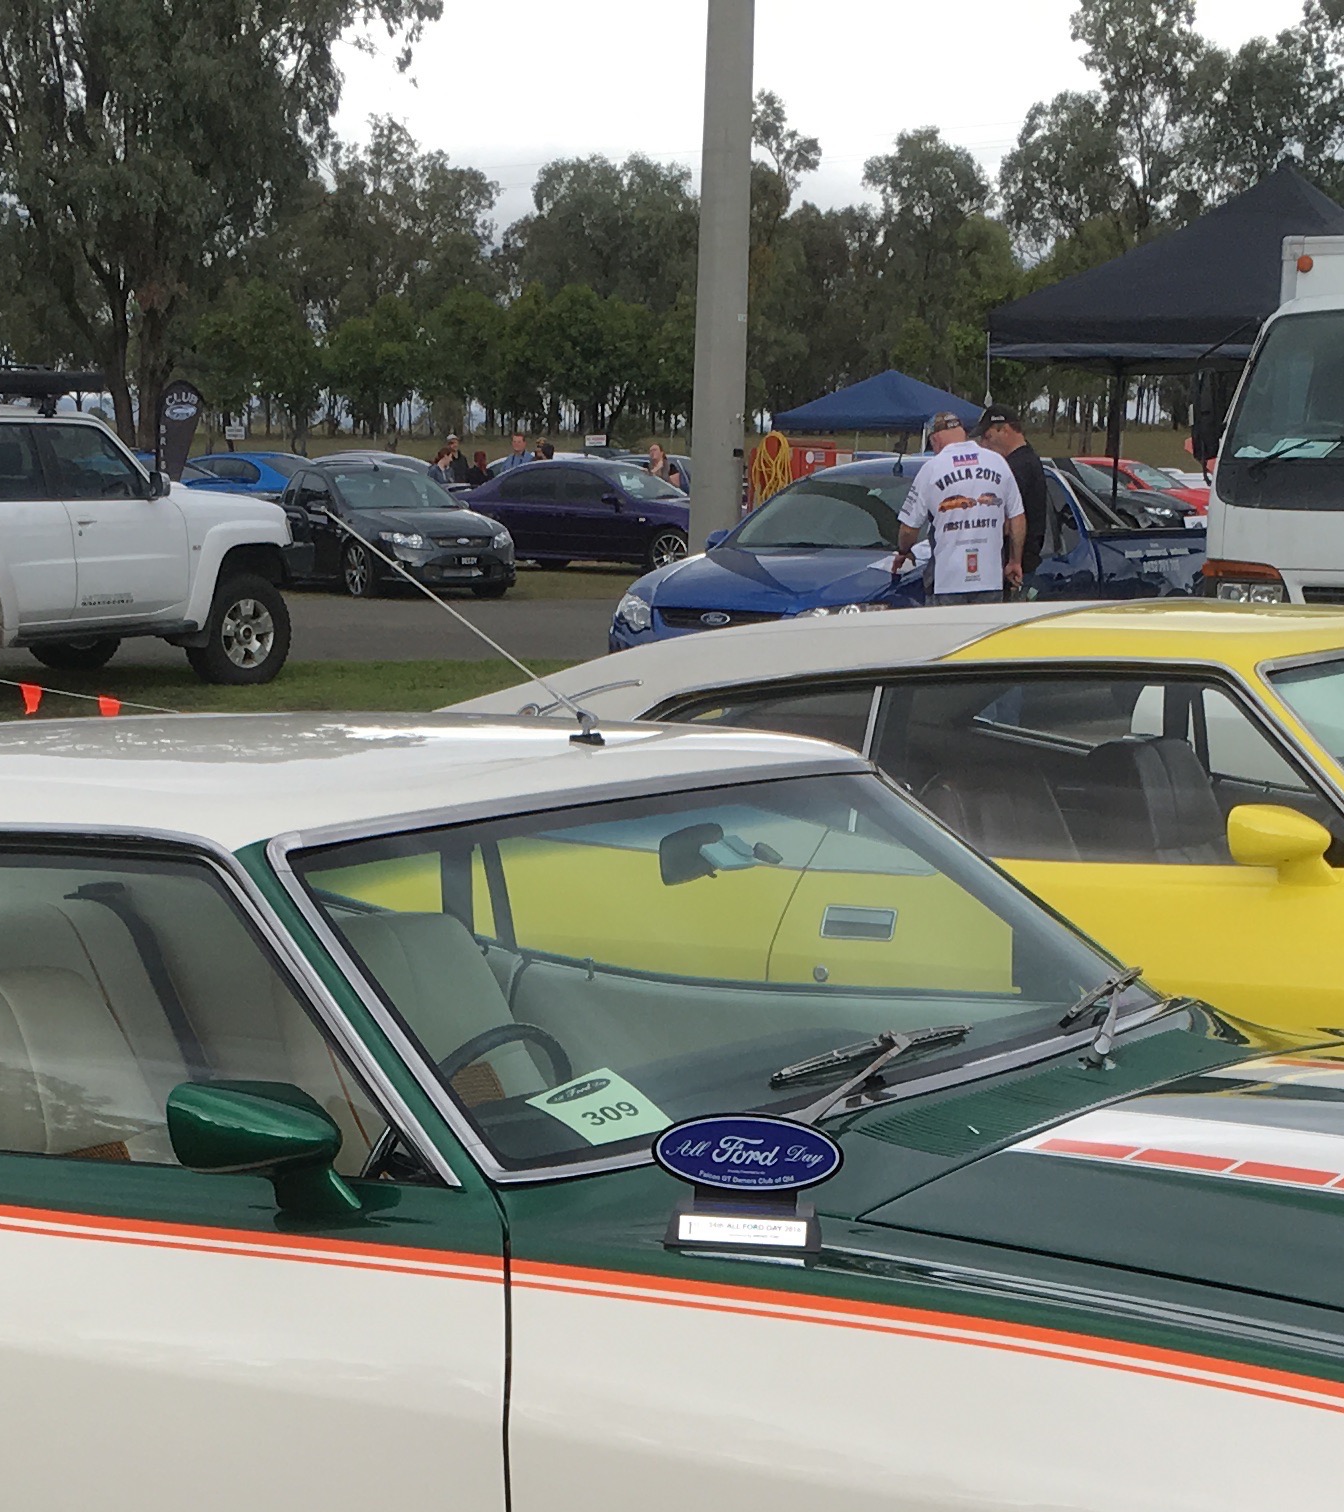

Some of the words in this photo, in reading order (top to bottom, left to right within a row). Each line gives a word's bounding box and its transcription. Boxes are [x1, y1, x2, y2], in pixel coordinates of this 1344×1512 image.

[166, 391, 198, 406] CLUB
[935, 468, 973, 491] VALLA
[975, 467, 1002, 485] 2015
[943, 521, 963, 532] FIRST
[972, 519, 990, 529] LAST
[581, 1101, 639, 1126] 309
[666, 1140, 712, 1158] All
[712, 1136, 781, 1166] Ford
[785, 1145, 824, 1169] Day
